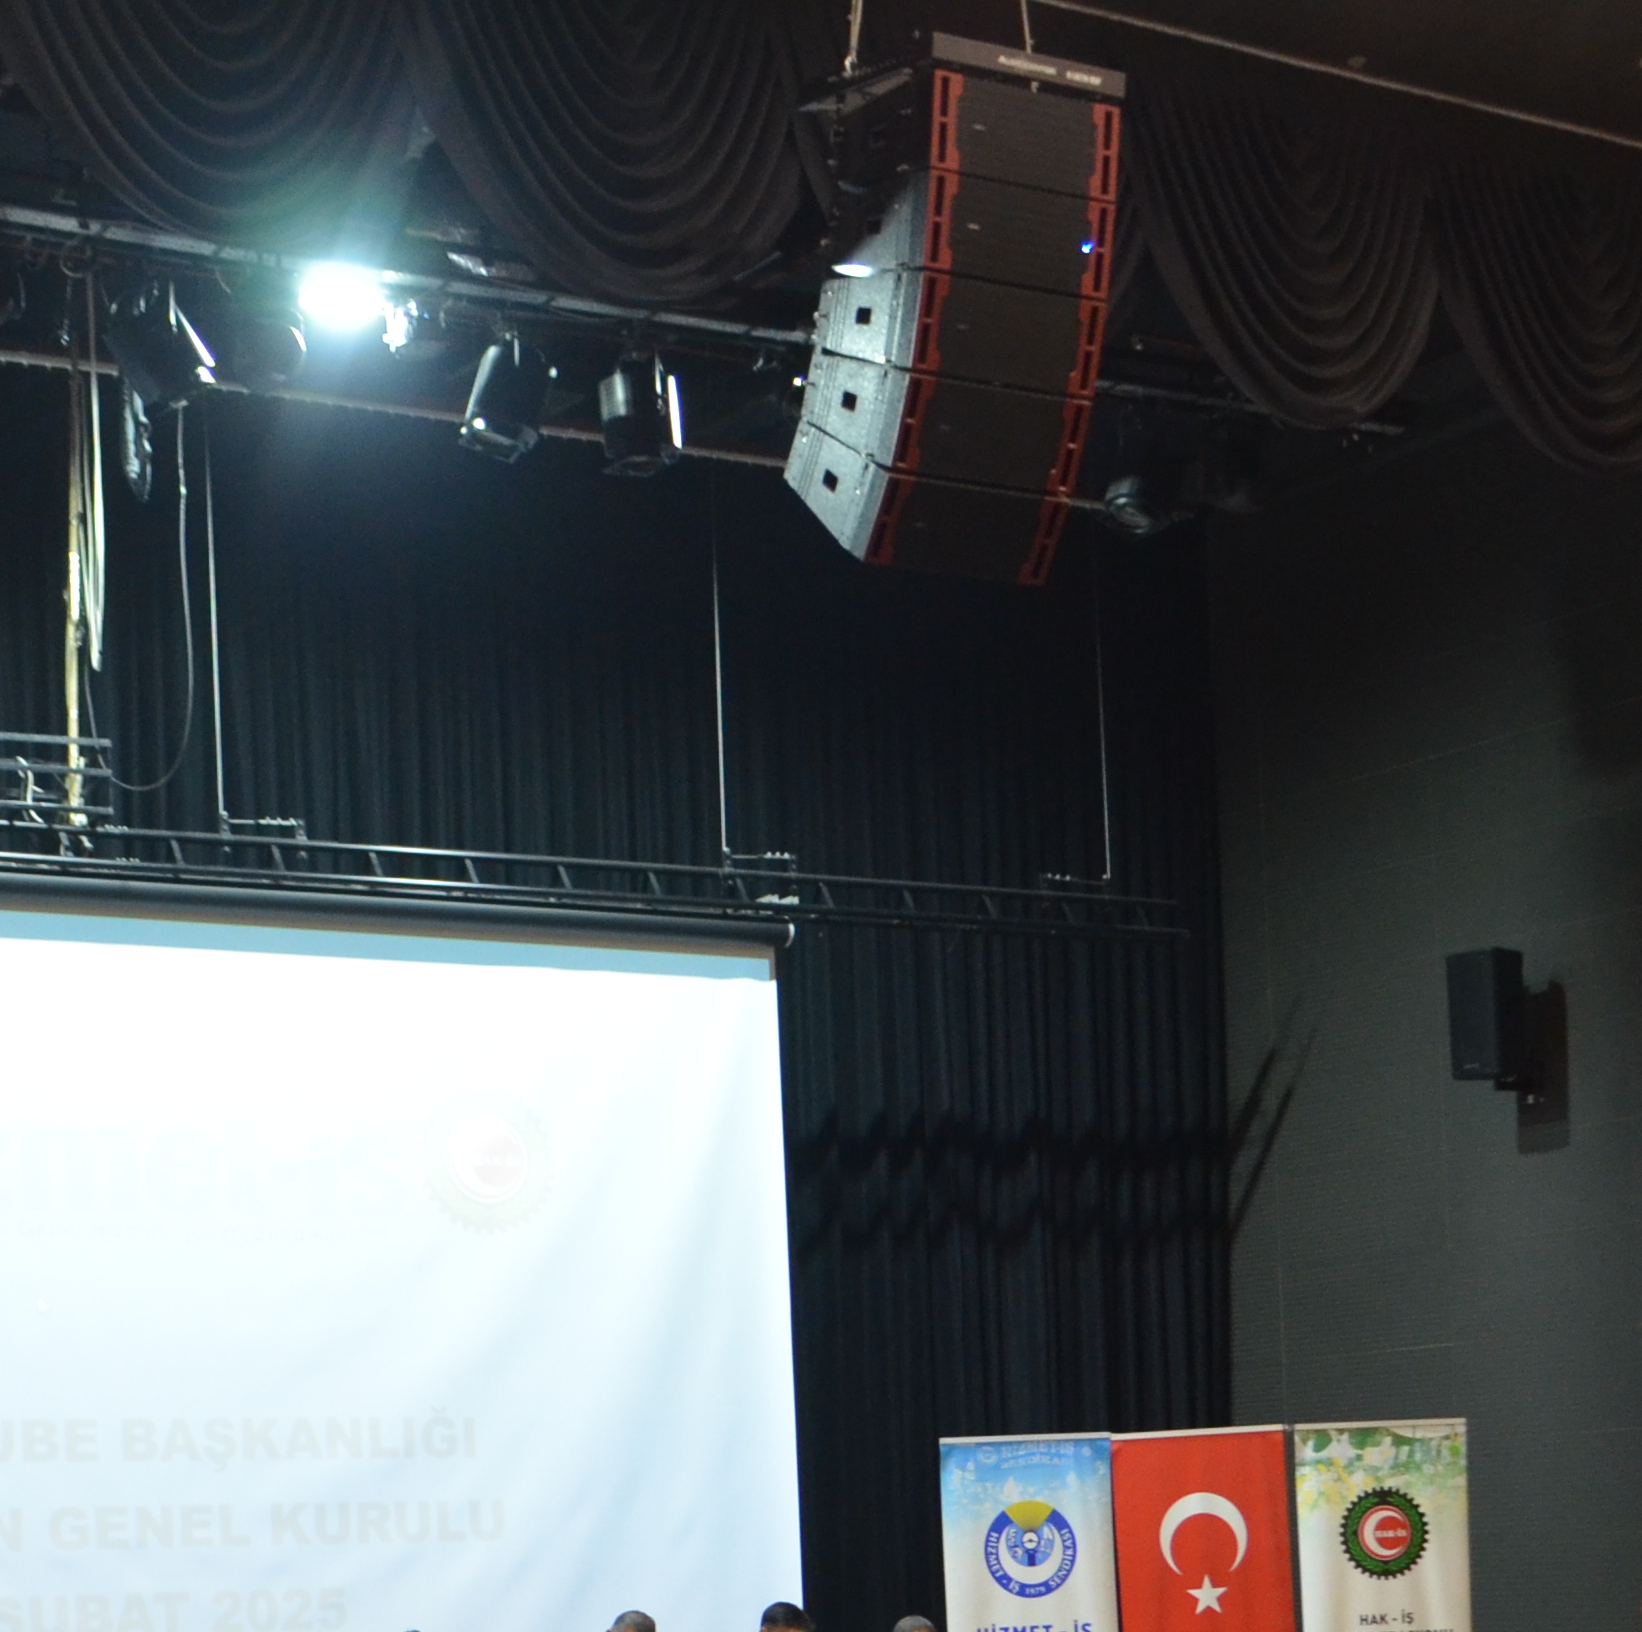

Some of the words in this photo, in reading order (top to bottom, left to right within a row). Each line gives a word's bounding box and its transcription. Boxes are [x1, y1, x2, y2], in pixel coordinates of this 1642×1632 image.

[120, 1405, 478, 1474] BAŞKANLIĞI
[48, 1503, 252, 1552] GENEL
[270, 1499, 506, 1546] KURULU
[1359, 1614, 1389, 1627] HAK
